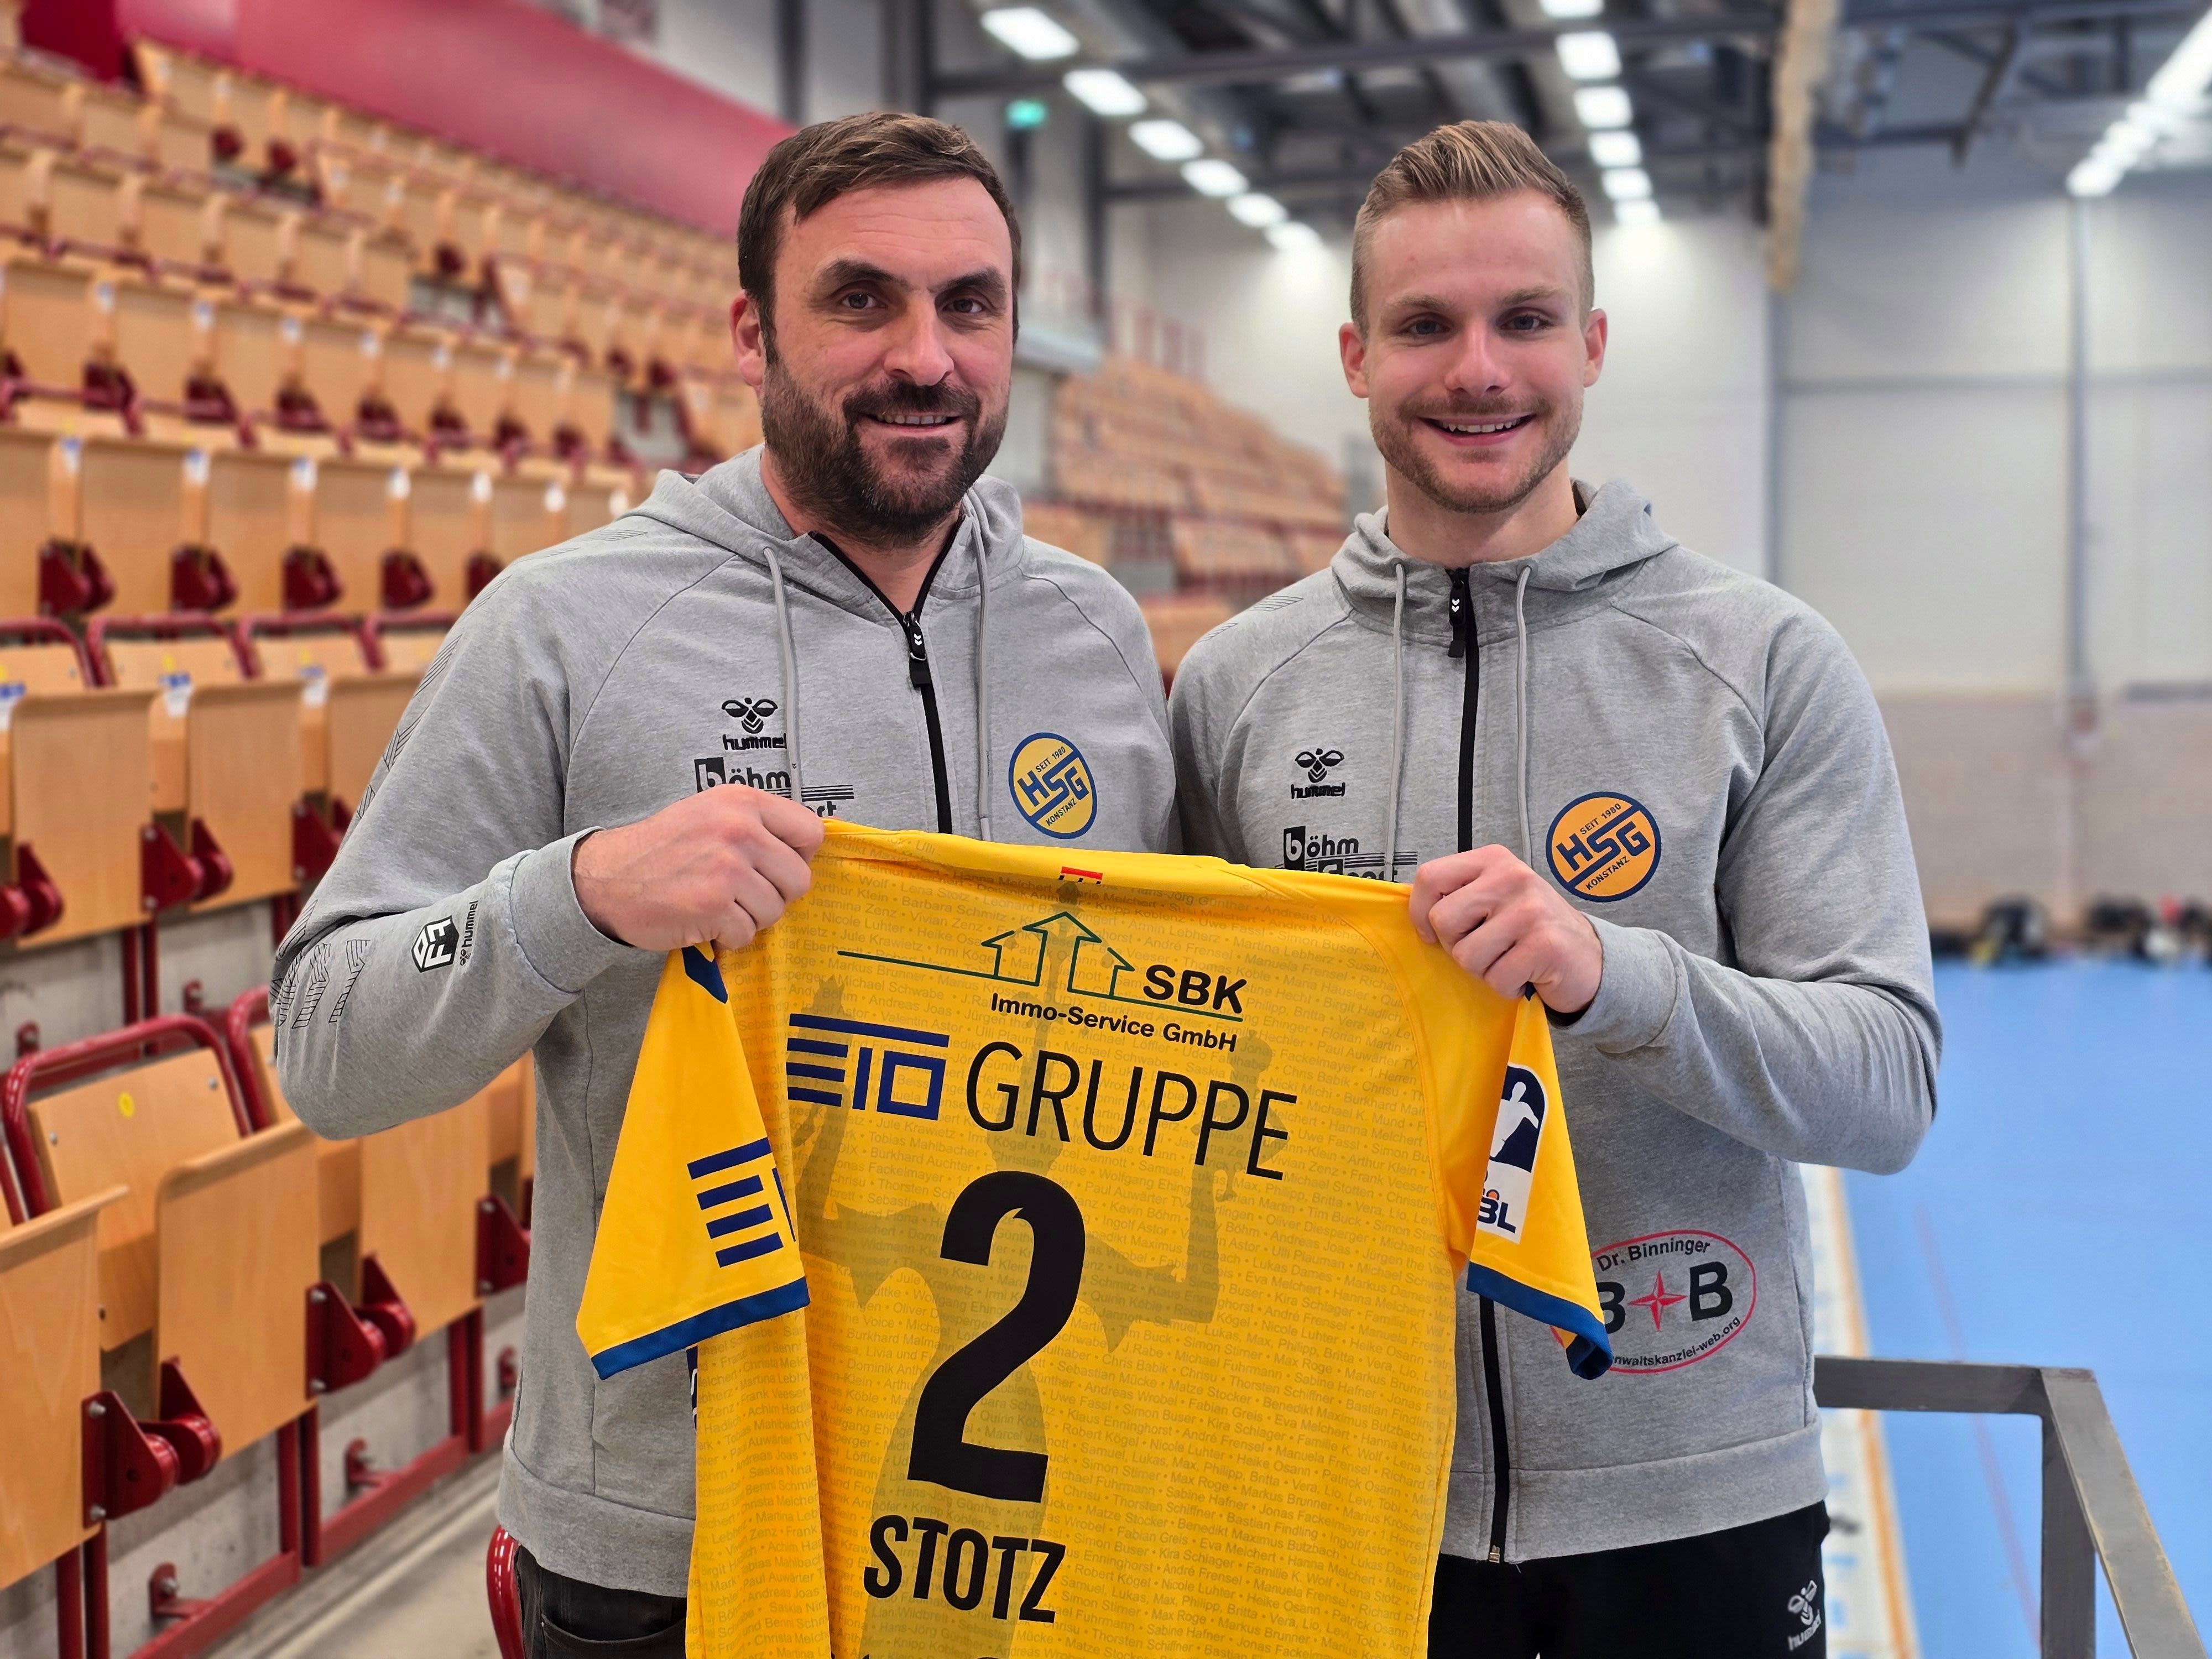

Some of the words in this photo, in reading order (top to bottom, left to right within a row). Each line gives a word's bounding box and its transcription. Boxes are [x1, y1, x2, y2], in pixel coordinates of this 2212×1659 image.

[723, 733, 787, 750] hummel
[1035, 758, 1051, 773] SEIT
[1017, 766, 1089, 807] HSG
[1291, 782, 1345, 799] hummel
[1046, 798, 1077, 826] KONSTANZ
[1580, 818, 1599, 834] SEIT
[1601, 804, 1621, 819] 1980
[1284, 828, 1359, 865] böhm
[1556, 821, 1651, 872] HSG
[1586, 856, 1630, 890] KONSTANZ
[461, 900, 479, 948] hummel
[1143, 964, 1247, 1014] SBK
[991, 993, 1155, 1037] Immo-Service
[1164, 1023, 1238, 1053] GmbH
[967, 1041, 1298, 1181] GRUPPE
[1478, 1196, 1516, 1233] BL
[1597, 1253, 1625, 1271] Dr.
[1627, 1238, 1710, 1261] Binninger
[1689, 1261, 1733, 1321] B
[907, 1171, 1086, 1503] 2
[1614, 1317, 1740, 1366] nwaltskanzlei-web.org
[863, 1514, 1066, 1624] STOTZ
